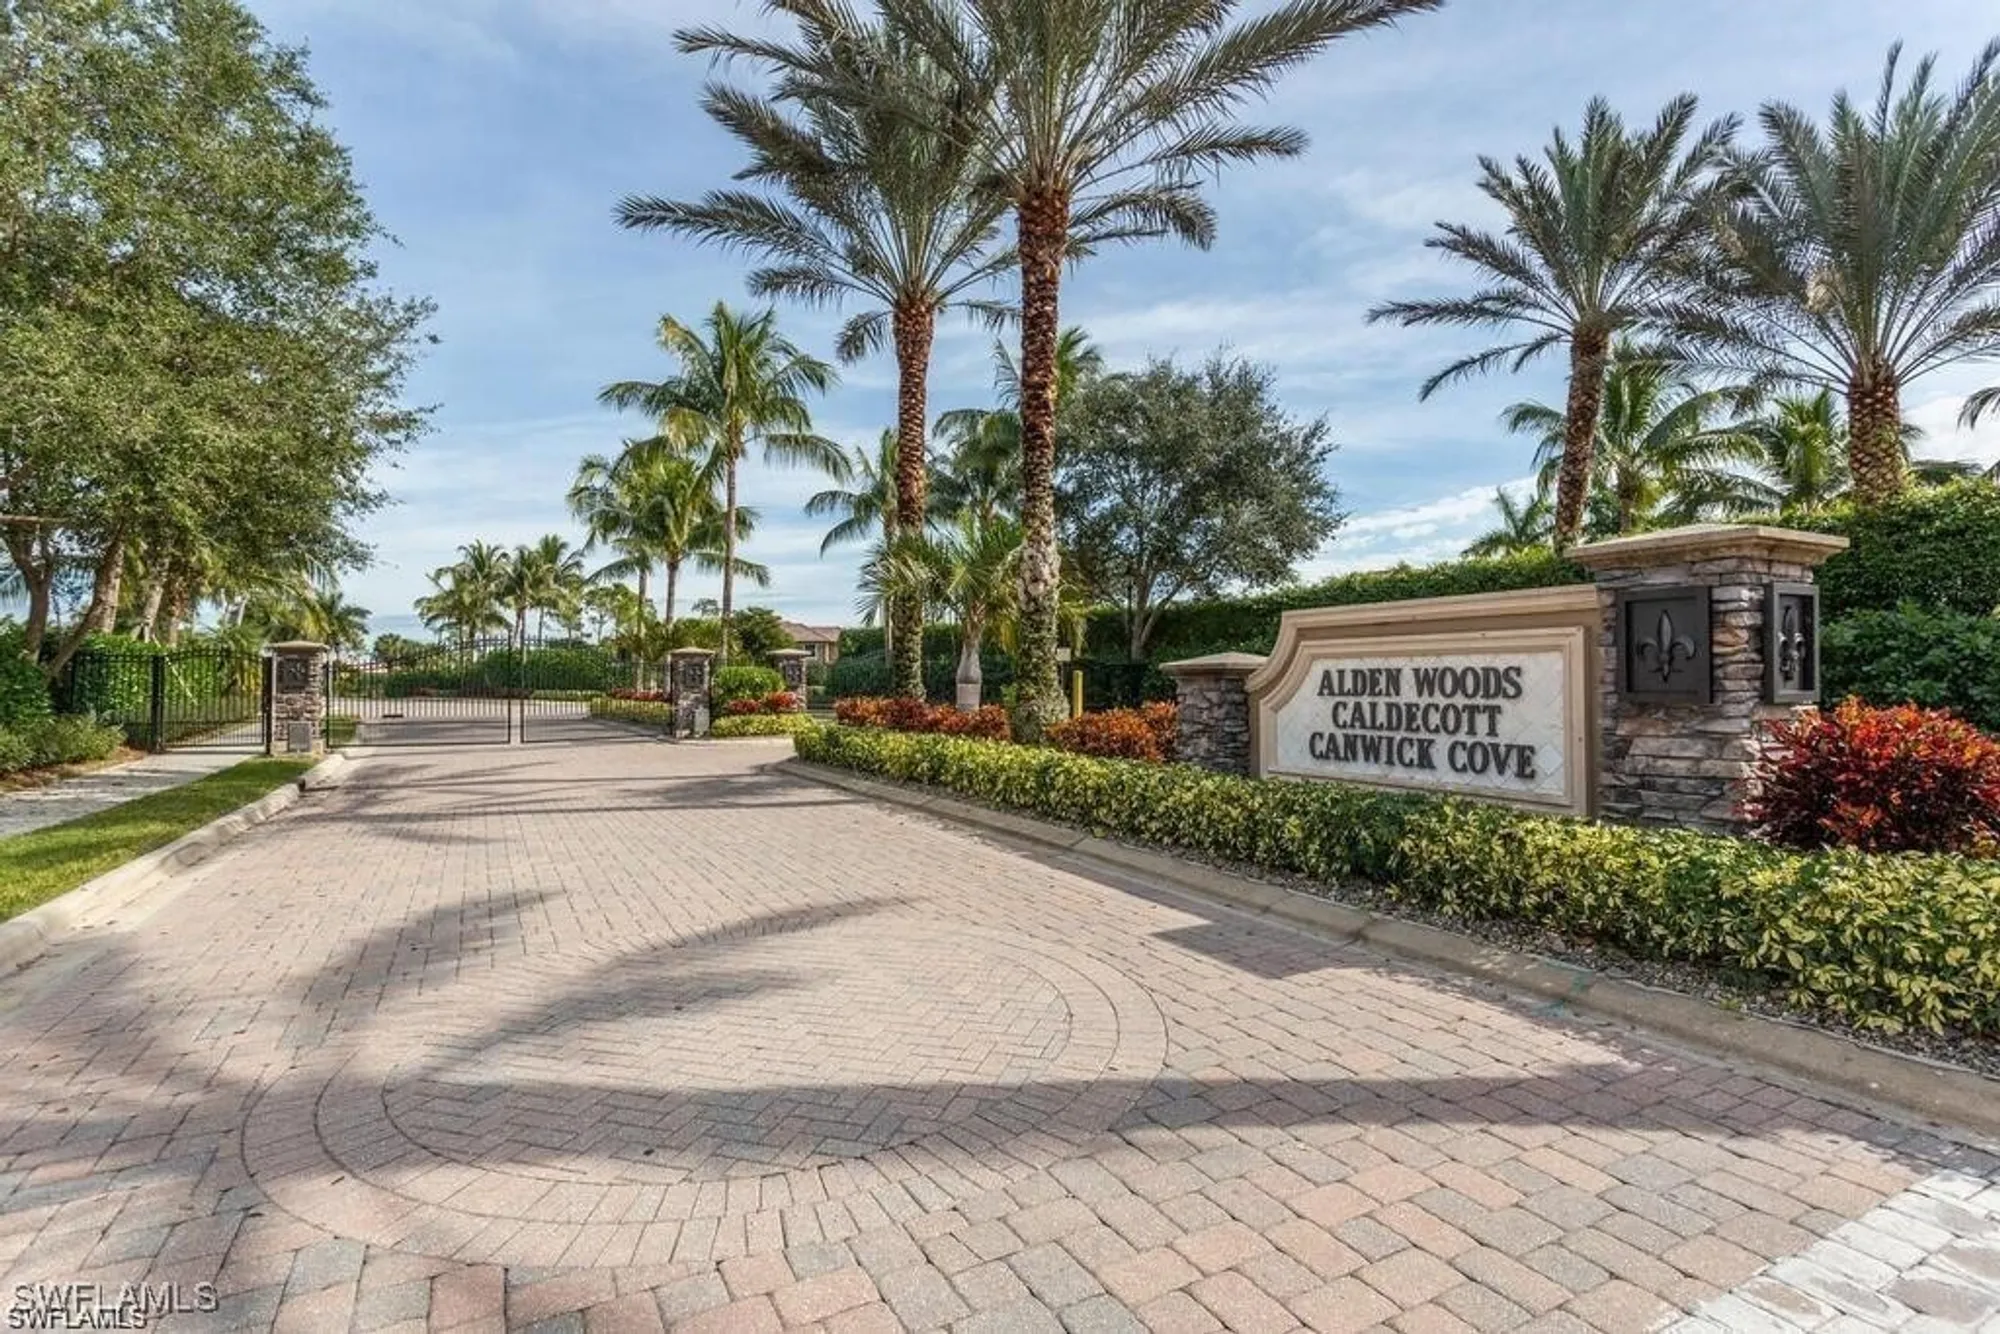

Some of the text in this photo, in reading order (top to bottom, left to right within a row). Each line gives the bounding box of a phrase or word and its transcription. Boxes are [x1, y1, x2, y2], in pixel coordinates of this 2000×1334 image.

[1317, 666, 1523, 699] ALDEN WOODS
[1332, 702, 1502, 737] CALDECOTT
[1309, 732, 1537, 779] CANWICK COVE
